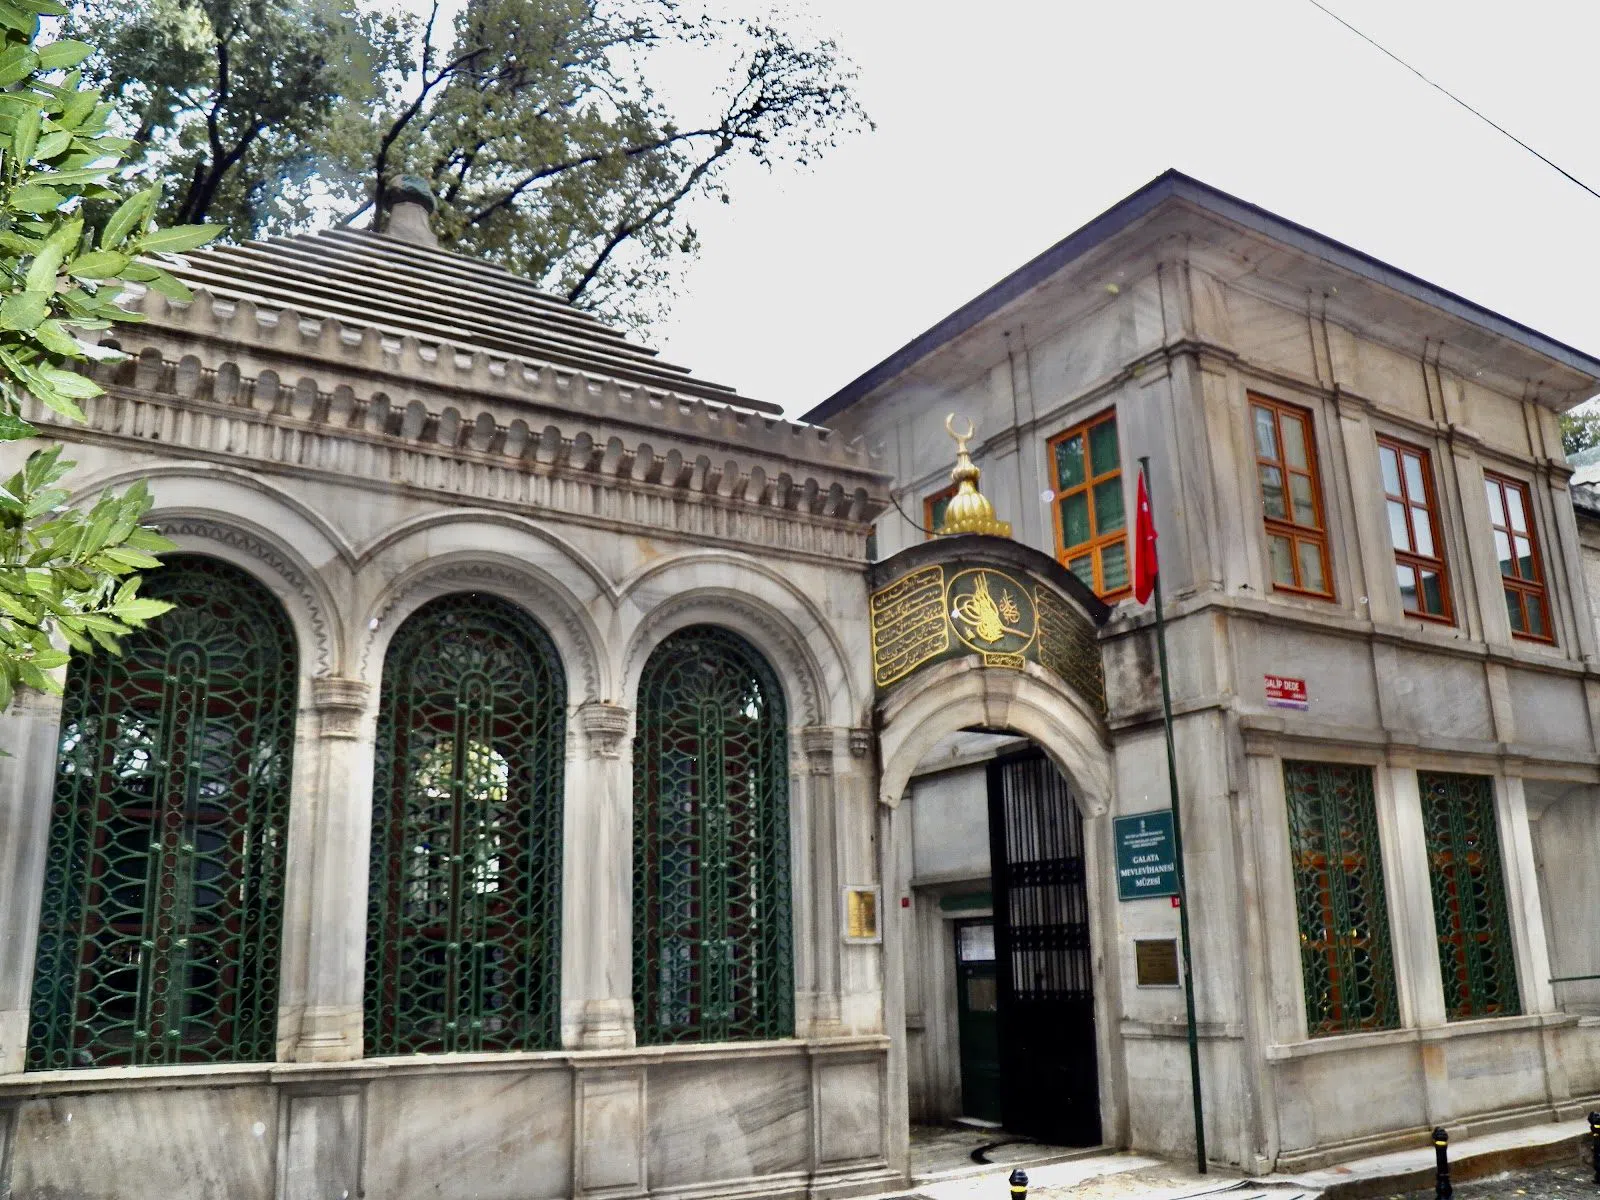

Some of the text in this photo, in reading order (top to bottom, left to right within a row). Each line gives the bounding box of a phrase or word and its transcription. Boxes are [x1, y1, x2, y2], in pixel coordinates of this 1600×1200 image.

[1133, 854, 1159, 864] GALATA
[1121, 862, 1174, 877] MEVLEVİHANESİ
[1136, 876, 1160, 887] MÜZESİ
